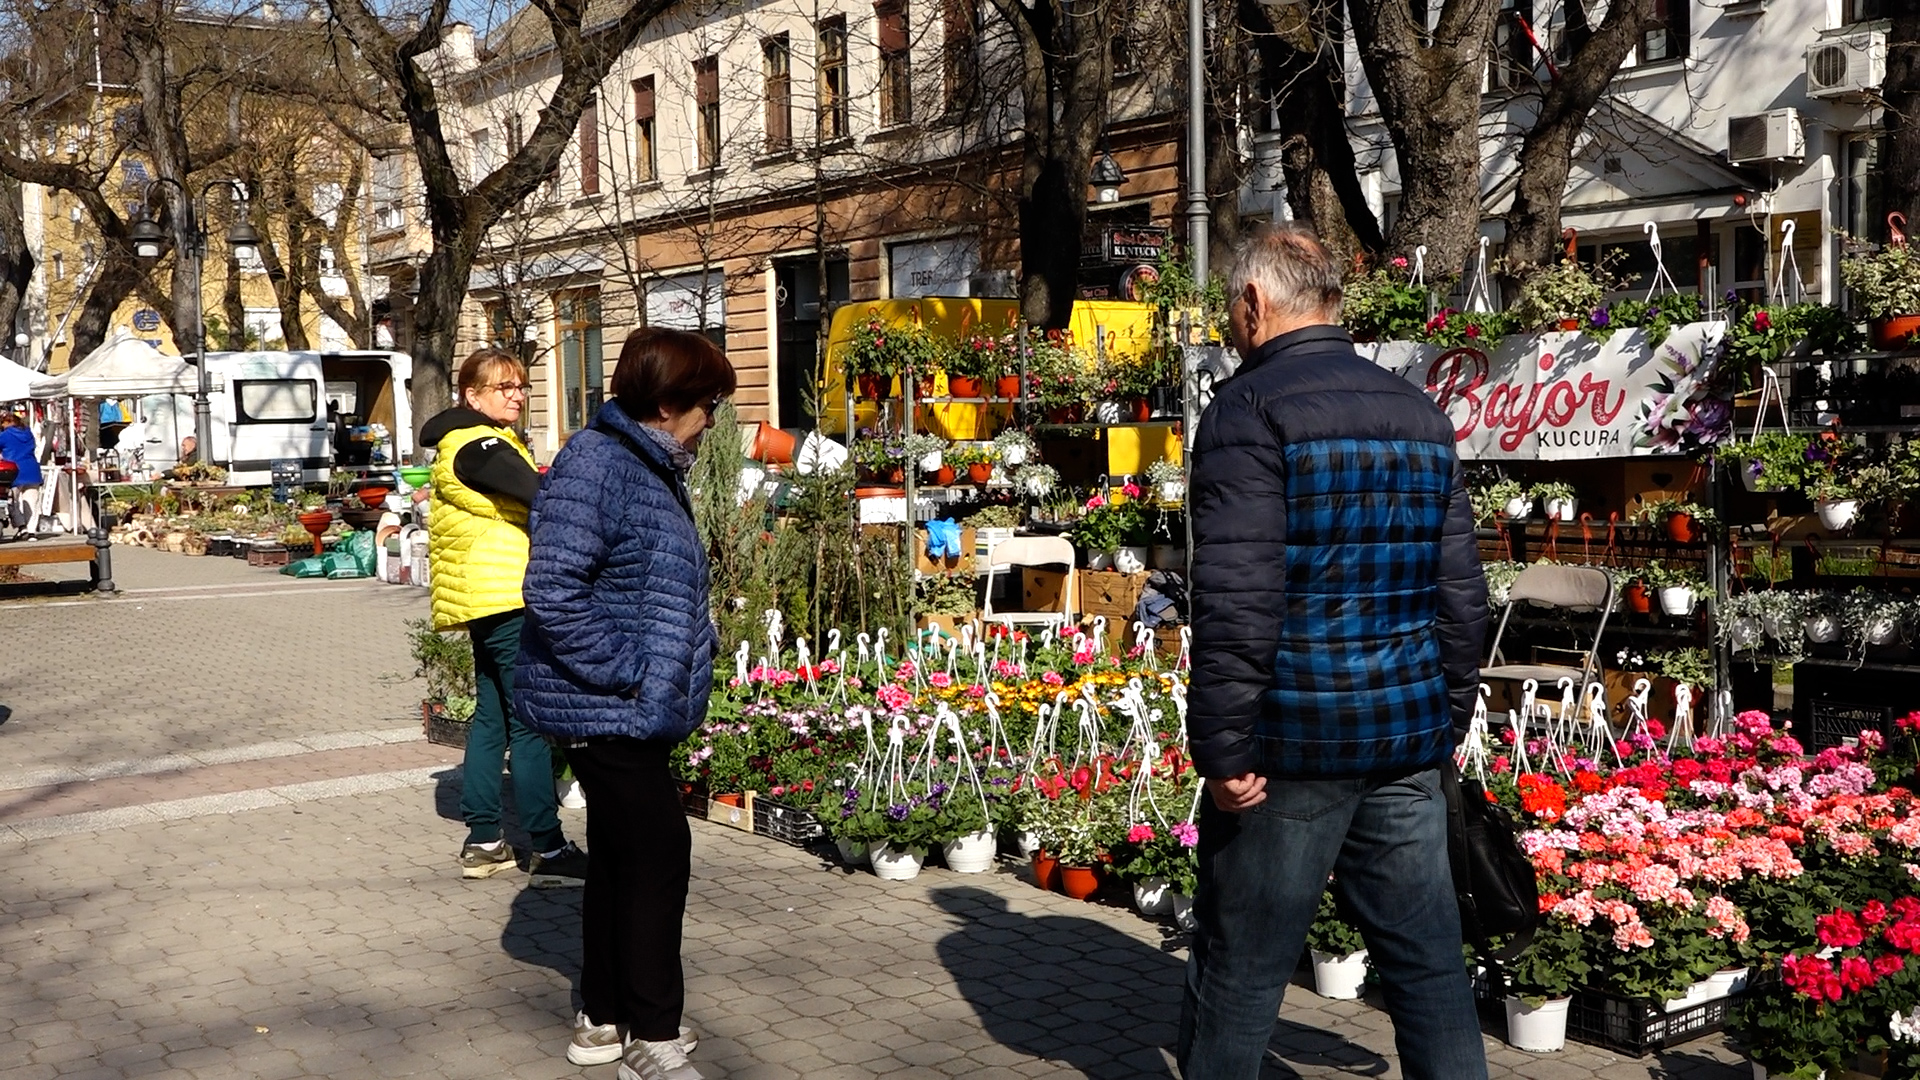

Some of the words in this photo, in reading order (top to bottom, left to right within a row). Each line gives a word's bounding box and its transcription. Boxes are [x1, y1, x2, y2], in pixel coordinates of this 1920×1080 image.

[1113, 246, 1162, 256] KENTUCKY
[1425, 347, 1626, 452] Bajor
[1537, 429, 1621, 448] KUCURA
